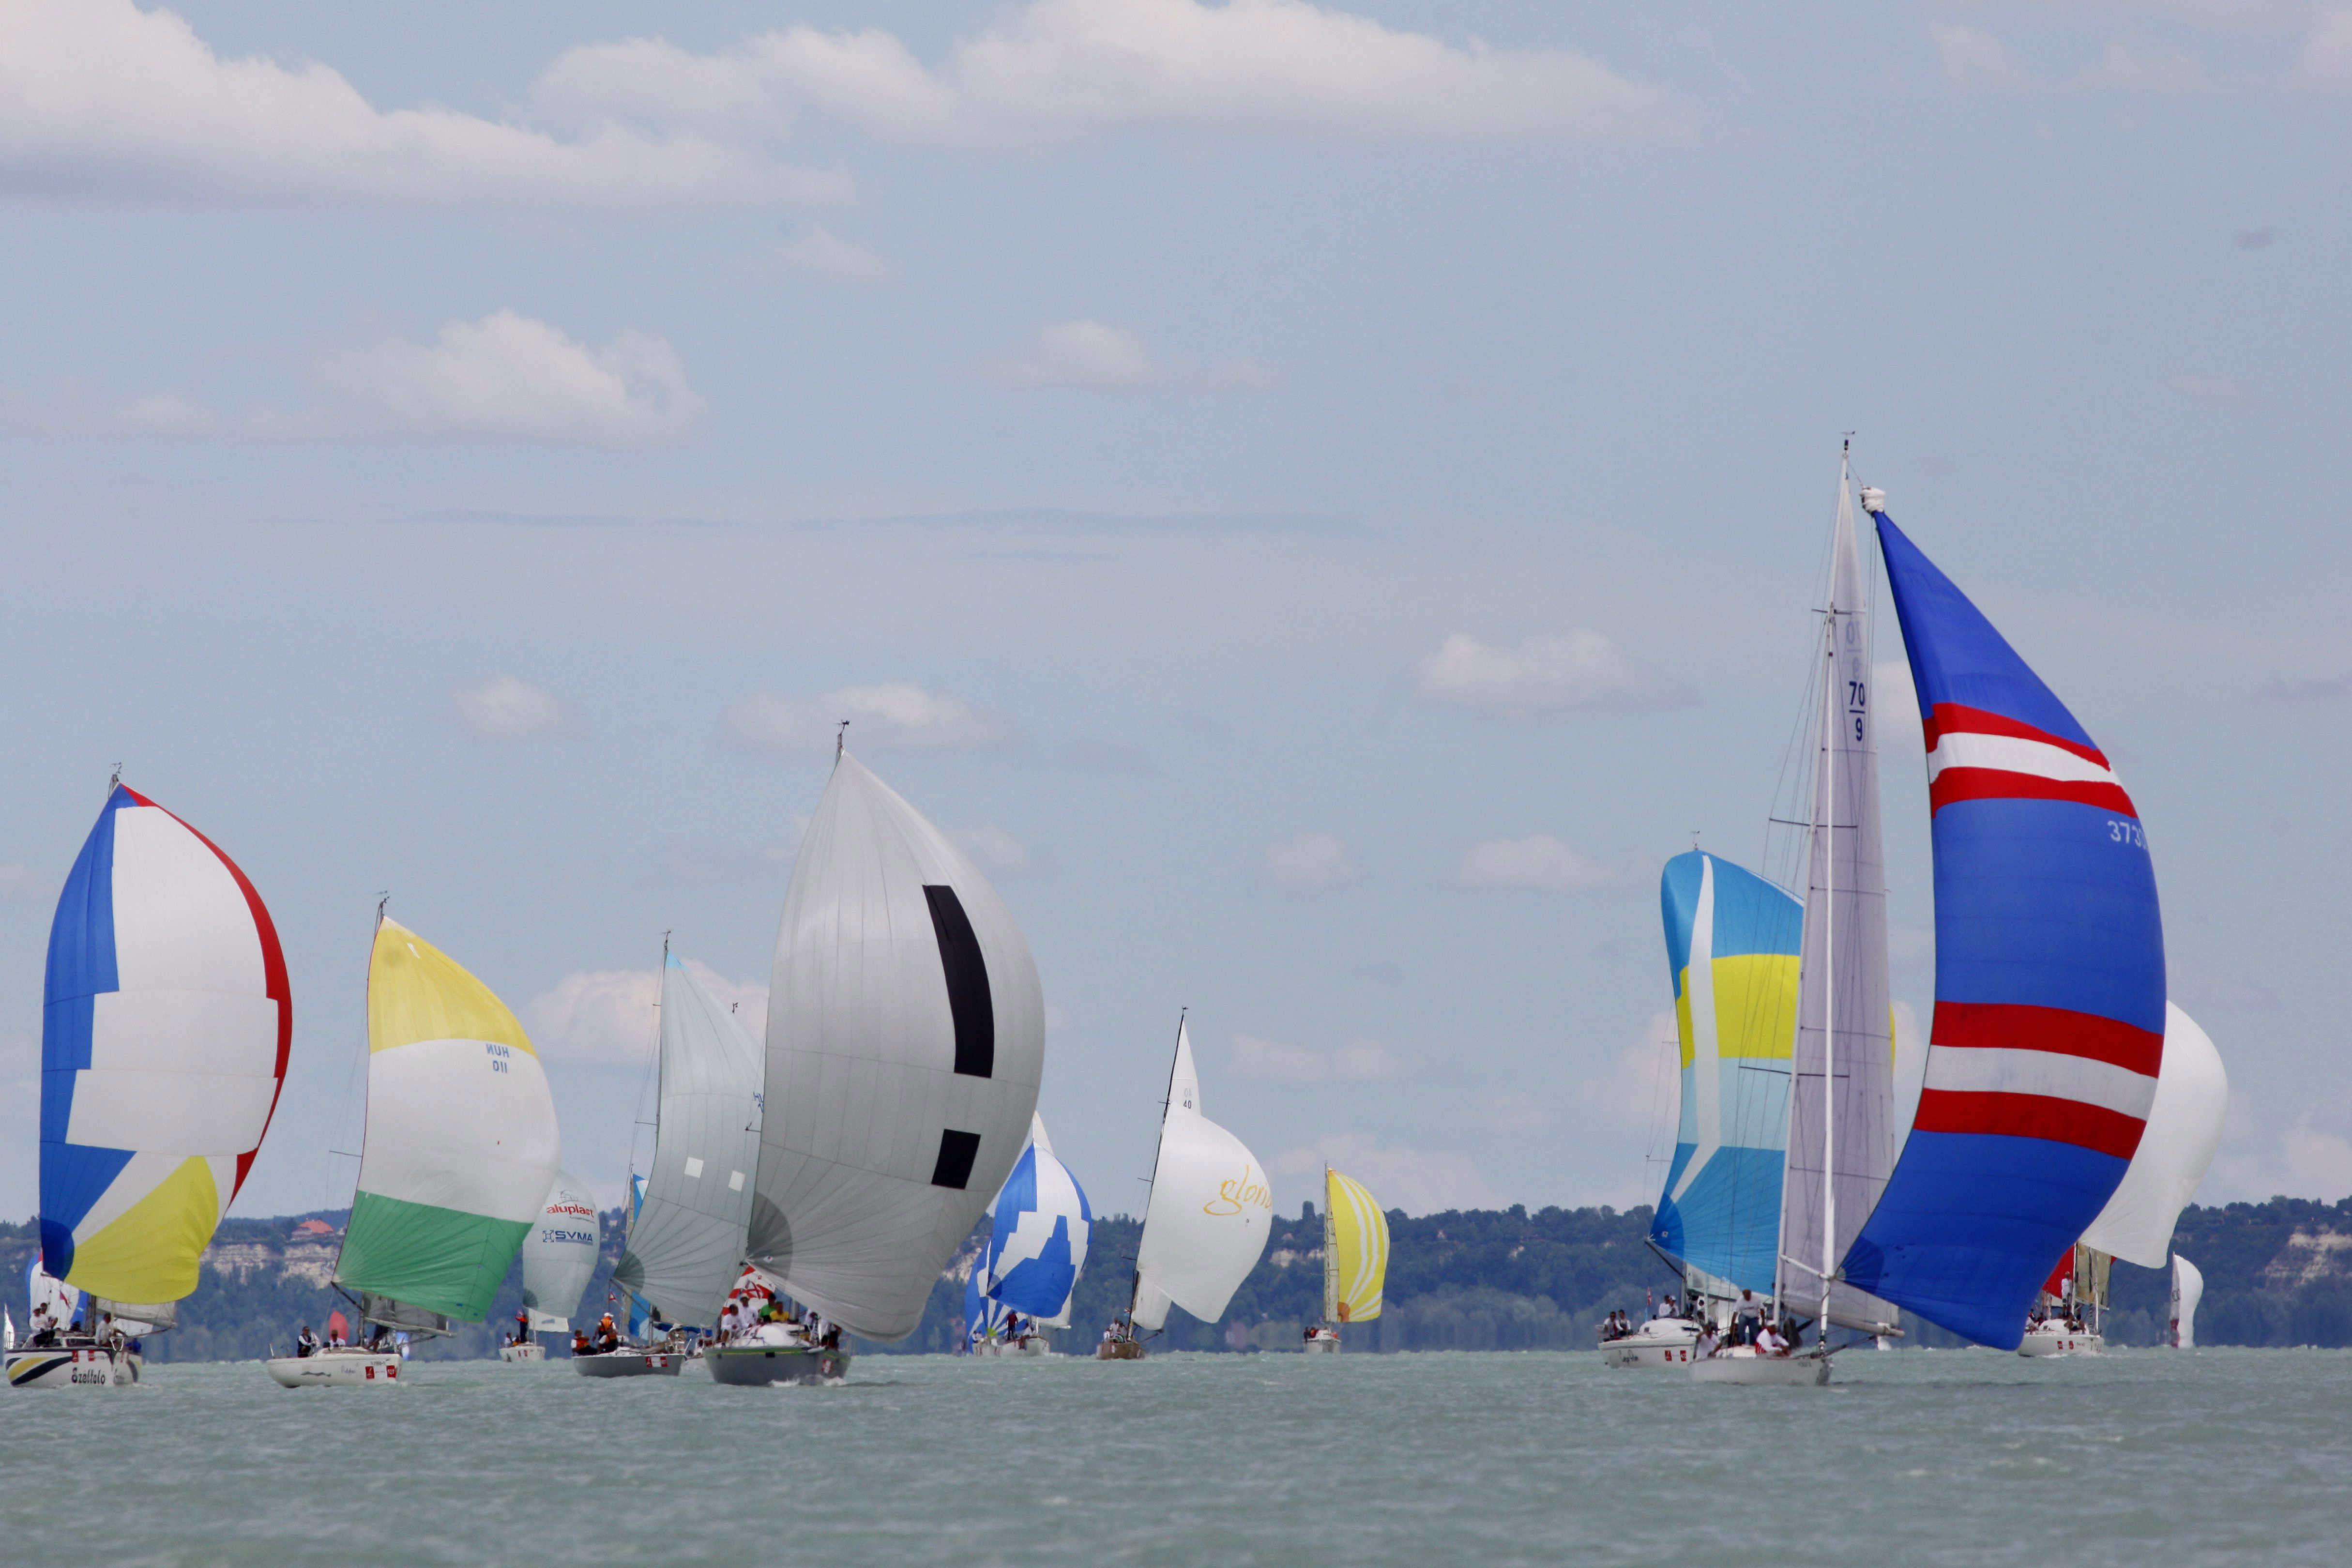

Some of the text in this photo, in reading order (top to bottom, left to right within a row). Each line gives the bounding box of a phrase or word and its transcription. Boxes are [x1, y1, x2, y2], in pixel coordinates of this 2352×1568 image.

[1849, 681, 1866, 707] 70
[1855, 717, 1863, 742] 9
[1183, 1099, 1192, 1109] 40
[546, 1204, 594, 1218] aluplast
